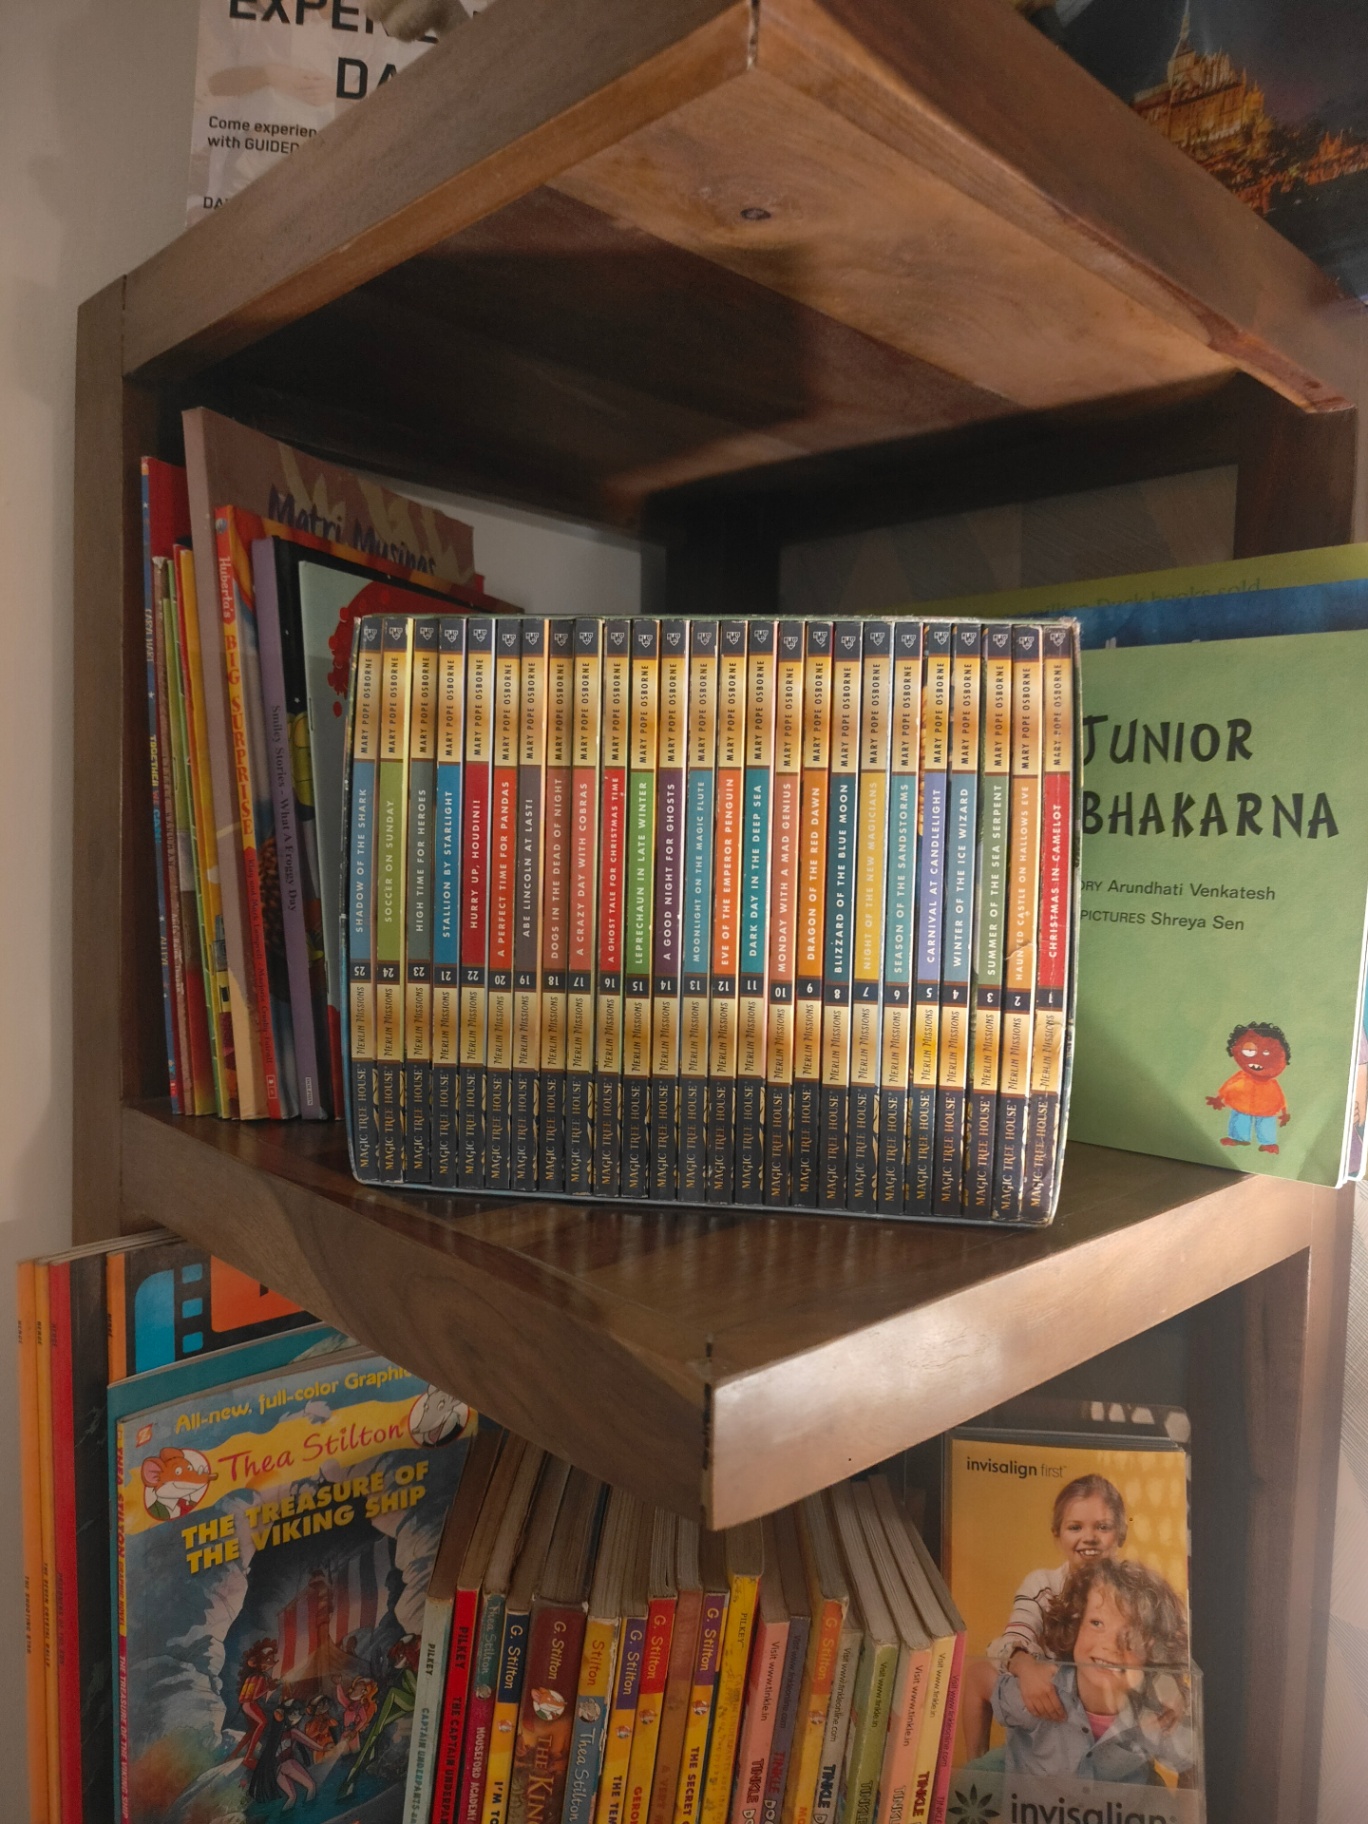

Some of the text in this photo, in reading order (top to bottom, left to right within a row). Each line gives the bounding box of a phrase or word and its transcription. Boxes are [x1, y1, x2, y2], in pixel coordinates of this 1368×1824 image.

[208, 136, 240, 149] with
[209, 116, 250, 131] Come
[218, 556, 253, 835] Huberta's BIG SURPRISE
[361, 658, 372, 753] MARY POPE OSBORNE
[869, 663, 881, 764] MARY POPE OSBORNE
[1082, 714, 1253, 766] JUNIOR
[150, 735, 159, 786] TOGETHER
[271, 705, 298, 912] Smiley Stories What A Froggy Day
[1082, 791, 1340, 839] BHAKARNA
[355, 788, 367, 933] SHADOW OF THE SHARK
[384, 800, 394, 922] SOCCER ON SUNDAY
[415, 789, 426, 932] HIGH TIME FOR HEROES
[442, 790, 452, 937] STALLION BY STARLIGHT
[470, 799, 480, 928] HURRY UP, HOUDINI!
[522, 799, 533, 937] ABE LINCOLN AT LAST!
[634, 782, 647, 964] LEPRECHAUN IN LATE WINTER
[833, 784, 848, 973] BLIZZARD OF THE BLUE MOON
[893, 784, 908, 973] SEASON OF THE SANDSTORMS
[926, 789, 941, 963] CARNIVAL AT CANDLELIGHT
[1048, 804, 1062, 958] CHRISTMAS IN CAMELOT
[1108, 880, 1276, 900] Arundhati Venkatesh
[1080, 910, 1244, 931] PICTURES Shreya Sen
[354, 966, 366, 976] 25
[382, 967, 394, 977] 24
[413, 966, 425, 976] 23
[467, 970, 479, 980] 22
[916, 1165, 929, 1200] MAGIC
[918, 1133, 929, 1160] TREE
[258, 1379, 340, 1415] full-color
[218, 1422, 404, 1482] Thea Stilton
[967, 1457, 1037, 1479] invisalign
[181, 1460, 429, 1550] THE TREASURE OF
[186, 1486, 426, 1575] THE VIKING SHIP
[481, 1634, 496, 1675] Stilton
[646, 1615, 666, 1679] G. Stilton
[817, 1617, 838, 1680] G. Stilton
[411, 1643, 436, 1811] PILKEY CAPTAIN UNDERPANTS
[446, 1626, 469, 1766] PILKEY THE CAPTAIN
[492, 1625, 523, 1803] G. Stilton I'M
[535, 1621, 567, 1769] G. Stilton THE
[568, 1640, 604, 1822] Stilton Thea Stilton
[611, 1629, 643, 1797] G. Stilton THE
[683, 1607, 720, 1816] G. Stilton THE SECRET
[747, 1641, 779, 1803] Visit www.tinkle.in TINKLE
[818, 1648, 851, 1808] Visit www.tinkleonline.com TINKLE
[871, 1662, 887, 1728] Visit www.tinkle.in
[903, 1665, 923, 1747] Visit www.tinkle.in
[913, 1653, 946, 1816] Visit www.tinkle.in TINKLE
[471, 1727, 486, 1778] MOUSEFORD
[769, 1752, 785, 1794] TINKLE
[121, 1796, 129, 1819] SHIP
[466, 1782, 480, 1821] ACADEMY
